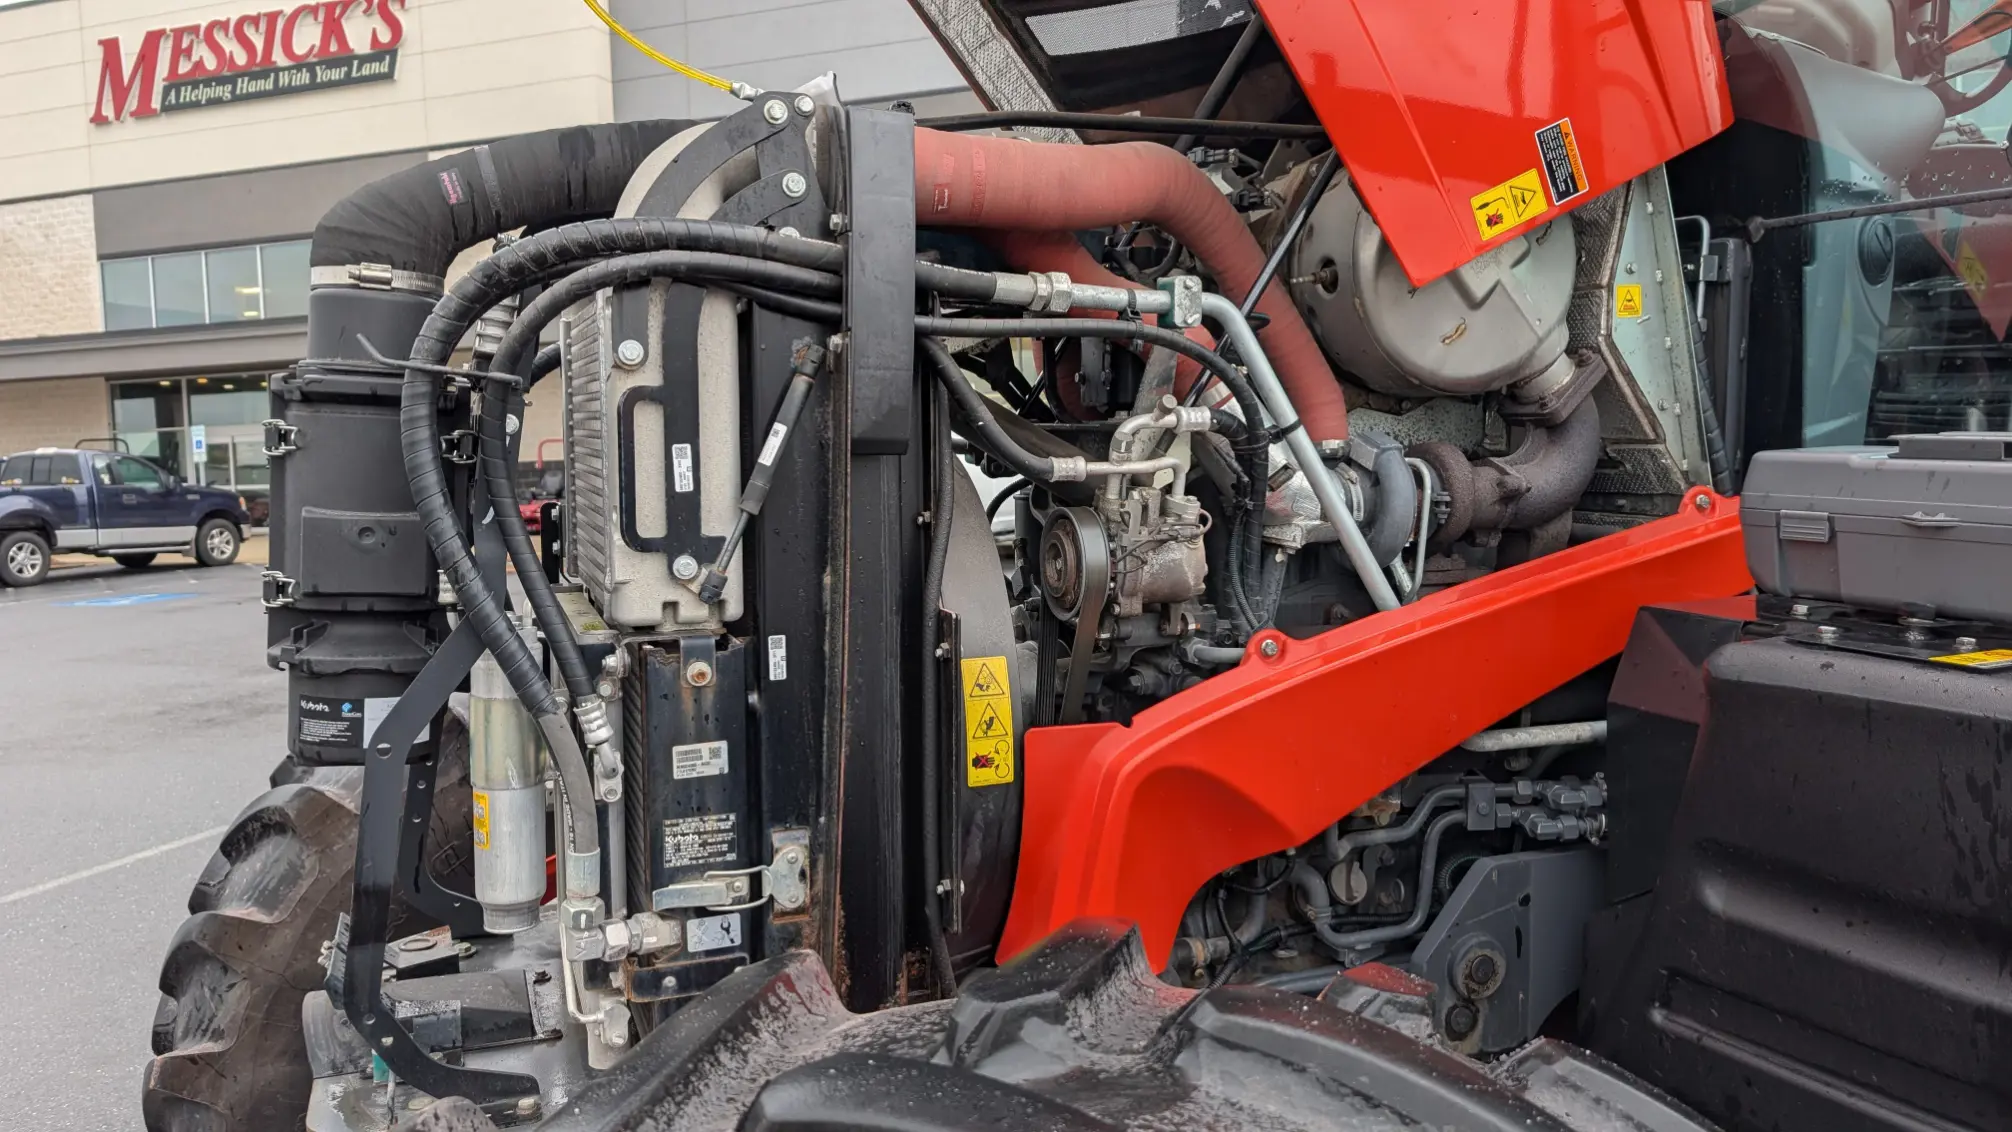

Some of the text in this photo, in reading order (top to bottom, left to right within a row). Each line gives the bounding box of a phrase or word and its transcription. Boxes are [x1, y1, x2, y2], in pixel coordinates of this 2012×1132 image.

[89, 0, 407, 123] MESSICK'S
[165, 56, 390, 105] A Helping Hand With Your Land
[1567, 140, 1583, 181] WARNING
[300, 699, 331, 713] Kubota
[665, 833, 699, 843] Kubota
